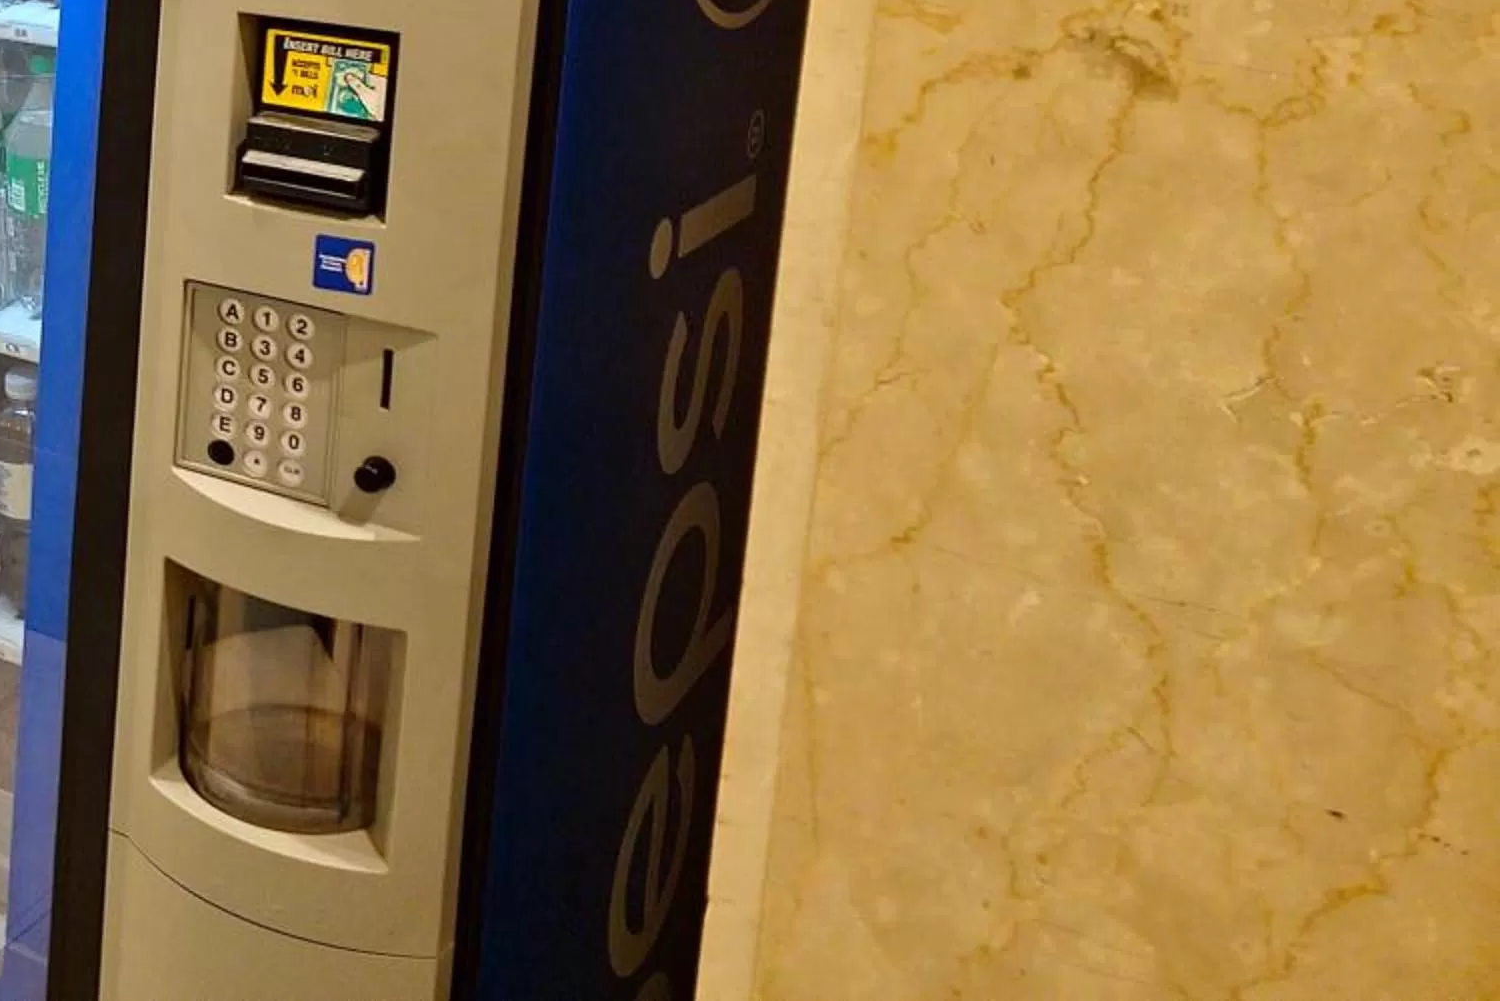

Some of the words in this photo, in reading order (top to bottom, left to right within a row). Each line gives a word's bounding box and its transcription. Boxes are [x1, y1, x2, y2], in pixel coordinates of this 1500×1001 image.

[283, 36, 320, 54] INSERT
[321, 44, 342, 57] BILL
[345, 48, 373, 62] HERE
[225, 303, 240, 320] A
[262, 311, 271, 327] 1
[296, 319, 309, 336] 2
[225, 331, 238, 348] B
[260, 340, 271, 356] 3
[294, 349, 306, 364] 4
[222, 360, 237, 376] C
[258, 368, 269, 384] 5
[293, 377, 304, 393] 6
[220, 387, 235, 404] D
[255, 397, 267, 414] 7
[290, 406, 301, 422] 8
[219, 416, 232, 433] E
[254, 425, 265, 441] 9
[288, 434, 300, 451] 0
[607, 174, 757, 1001] epsi
